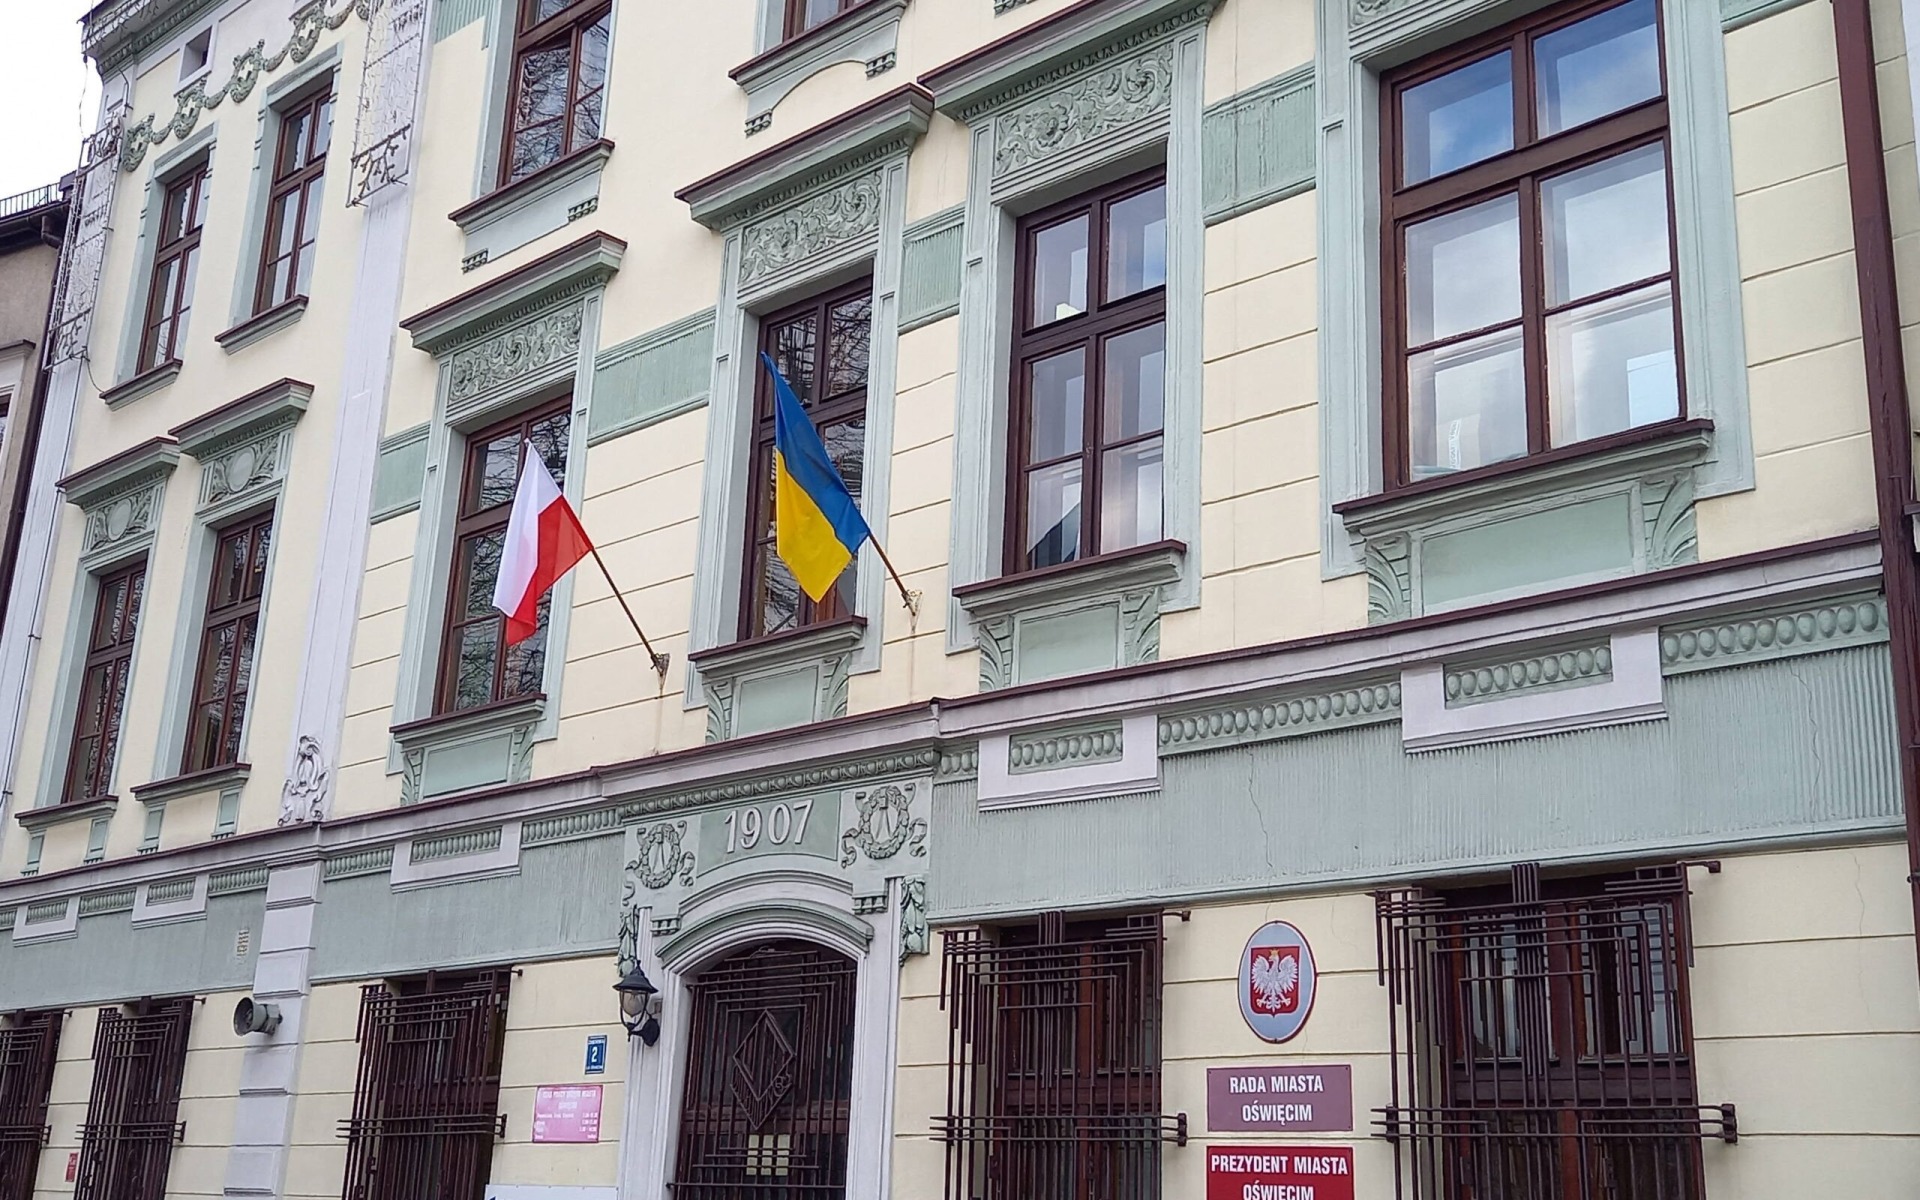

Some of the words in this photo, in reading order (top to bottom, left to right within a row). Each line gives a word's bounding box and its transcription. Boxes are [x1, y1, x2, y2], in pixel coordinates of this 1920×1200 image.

[724, 799, 814, 854] 1907
[591, 1046, 598, 1063] 2
[1230, 1076, 1267, 1093] RADA
[1271, 1075, 1324, 1093] MIASTA
[1242, 1100, 1312, 1126] OŚWIĘCIM
[1211, 1155, 1288, 1173] PREZYDENT
[1294, 1156, 1349, 1175] MIASTA
